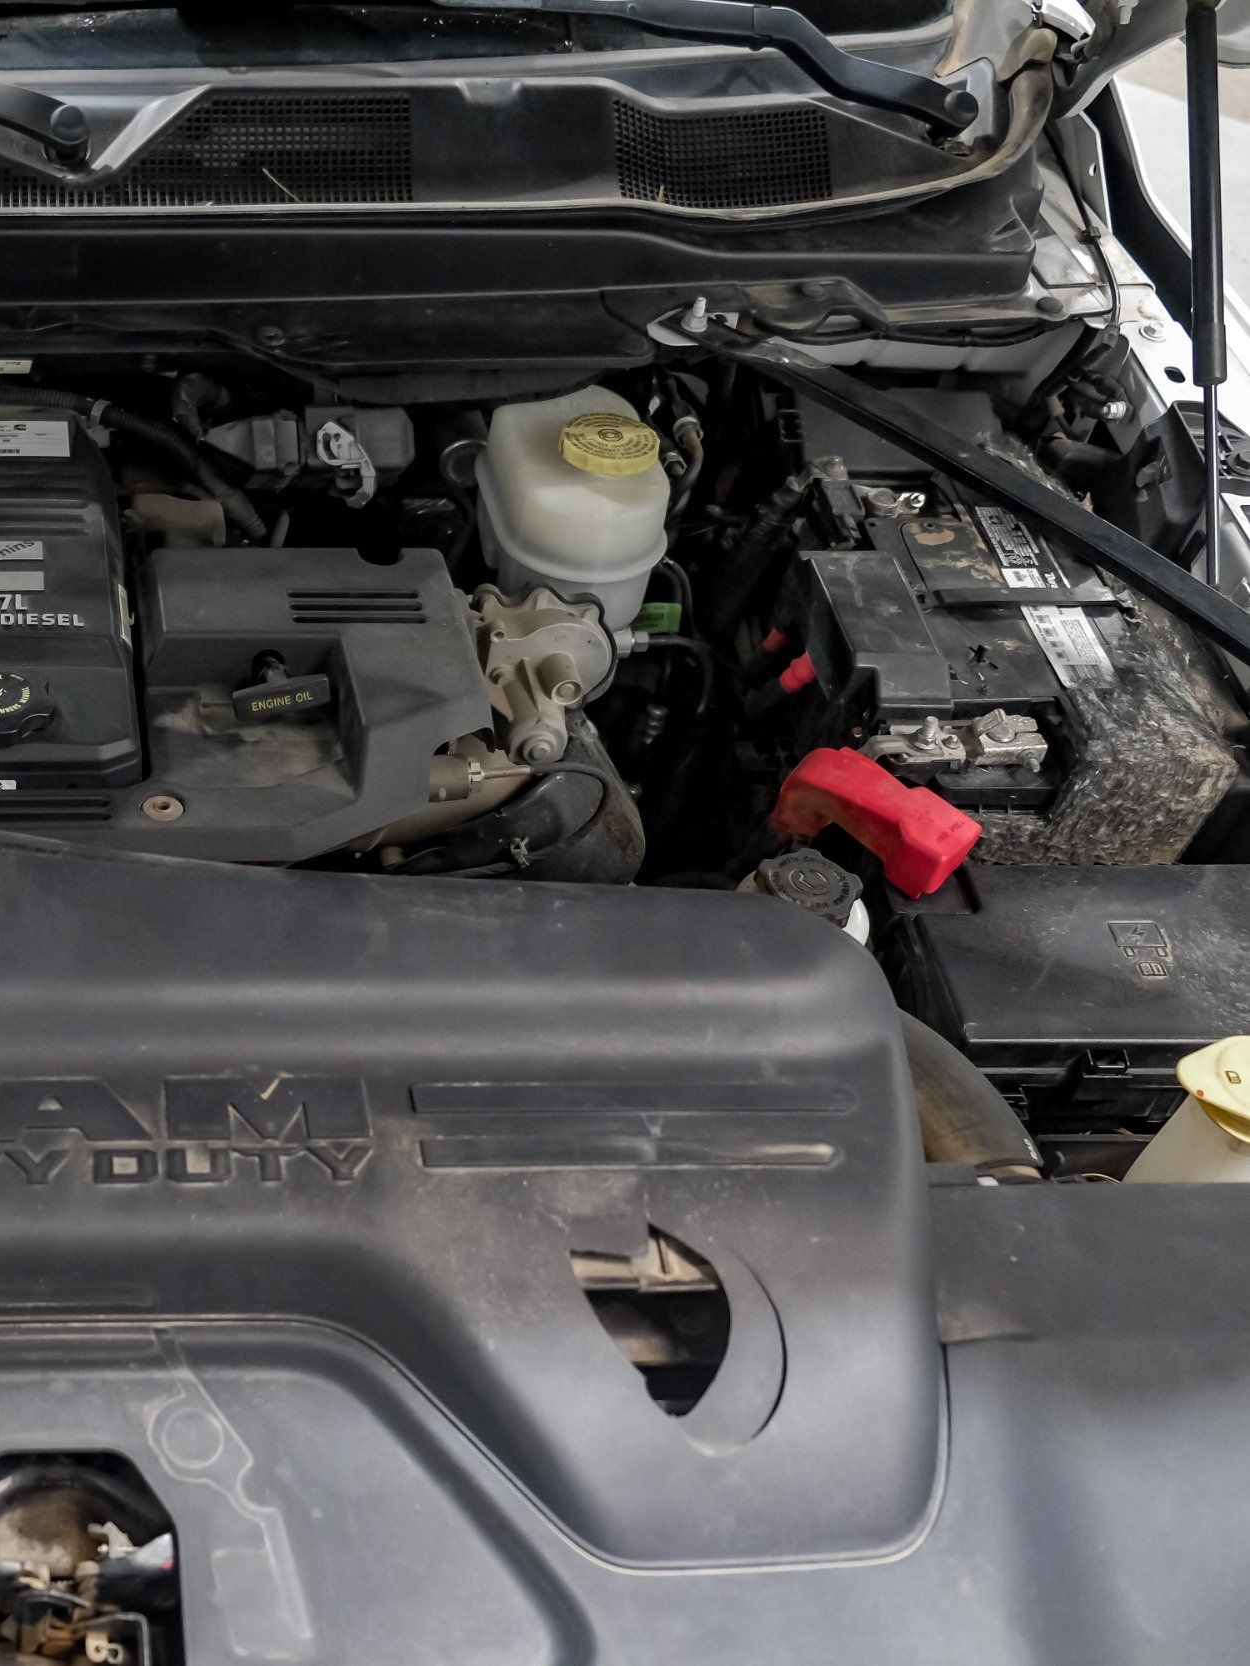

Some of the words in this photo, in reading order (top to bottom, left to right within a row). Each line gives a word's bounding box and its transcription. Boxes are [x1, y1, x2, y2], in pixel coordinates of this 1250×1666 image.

[0, 612, 85, 628] DIESEL
[251, 695, 291, 712] ENGINE
[295, 691, 313, 703] OIL
[92, 1142, 375, 1187] DUTY
